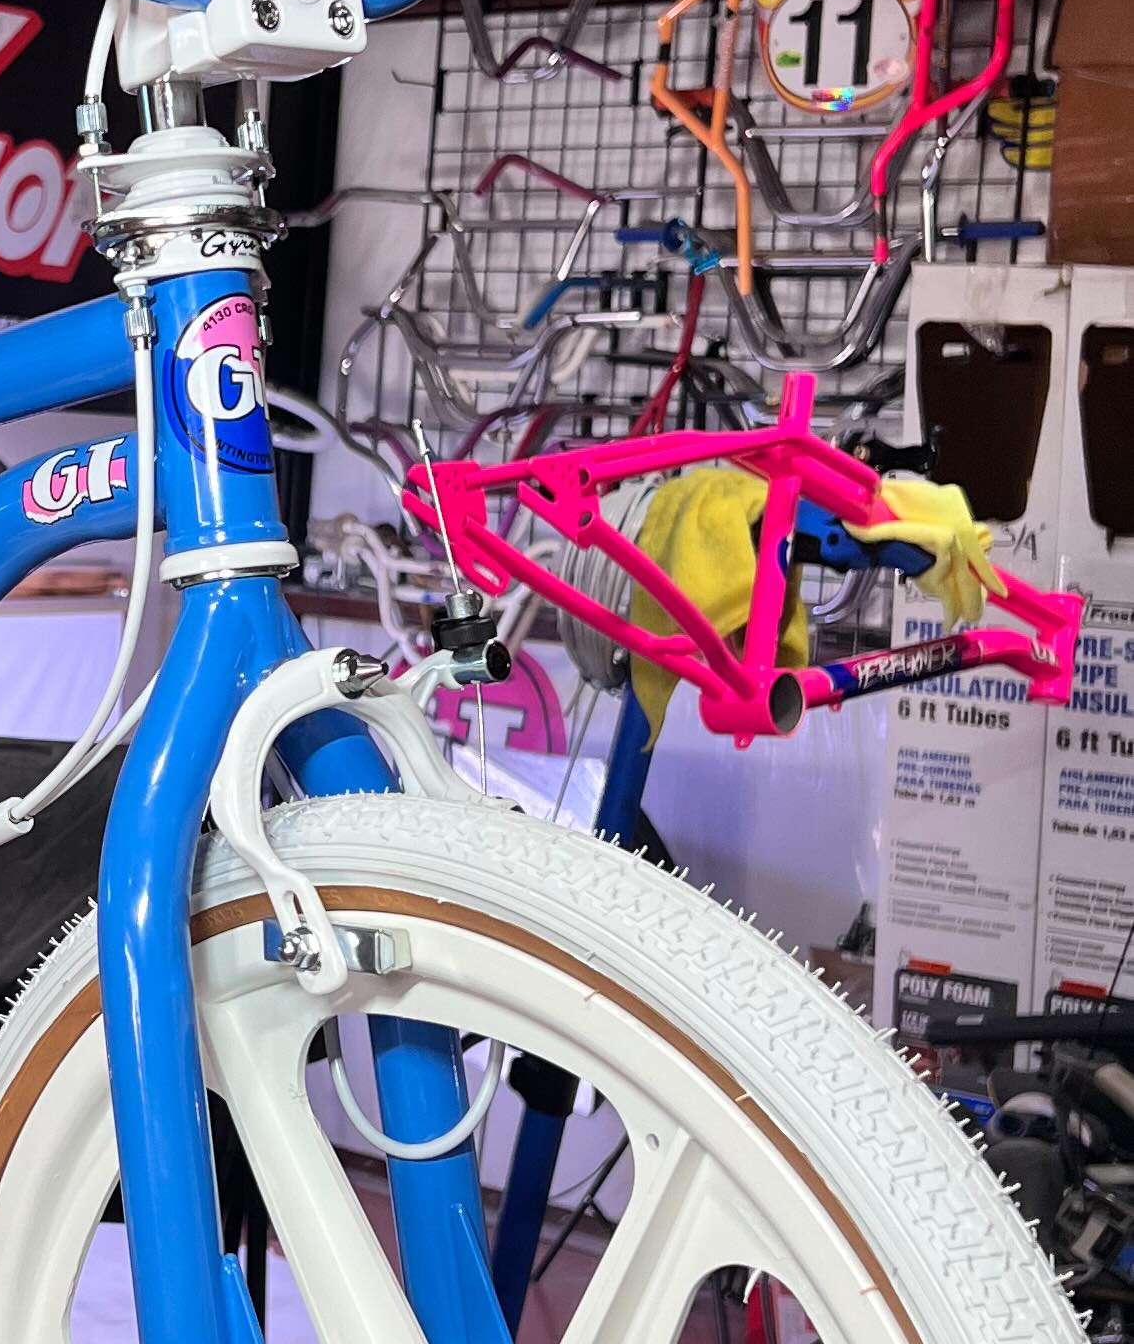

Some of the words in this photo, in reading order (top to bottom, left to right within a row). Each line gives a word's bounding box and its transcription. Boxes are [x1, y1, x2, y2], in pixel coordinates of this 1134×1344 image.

[203, 306, 232, 332] 4130
[30, 436, 128, 513] GT
[897, 697, 911, 719] 6
[920, 700, 936, 722] ft
[945, 701, 1010, 731] Tubes
[1056, 727, 1071, 751] 6
[1080, 728, 1099, 755] ft
[898, 972, 940, 999] POLY
[942, 980, 991, 1009] FOAM
